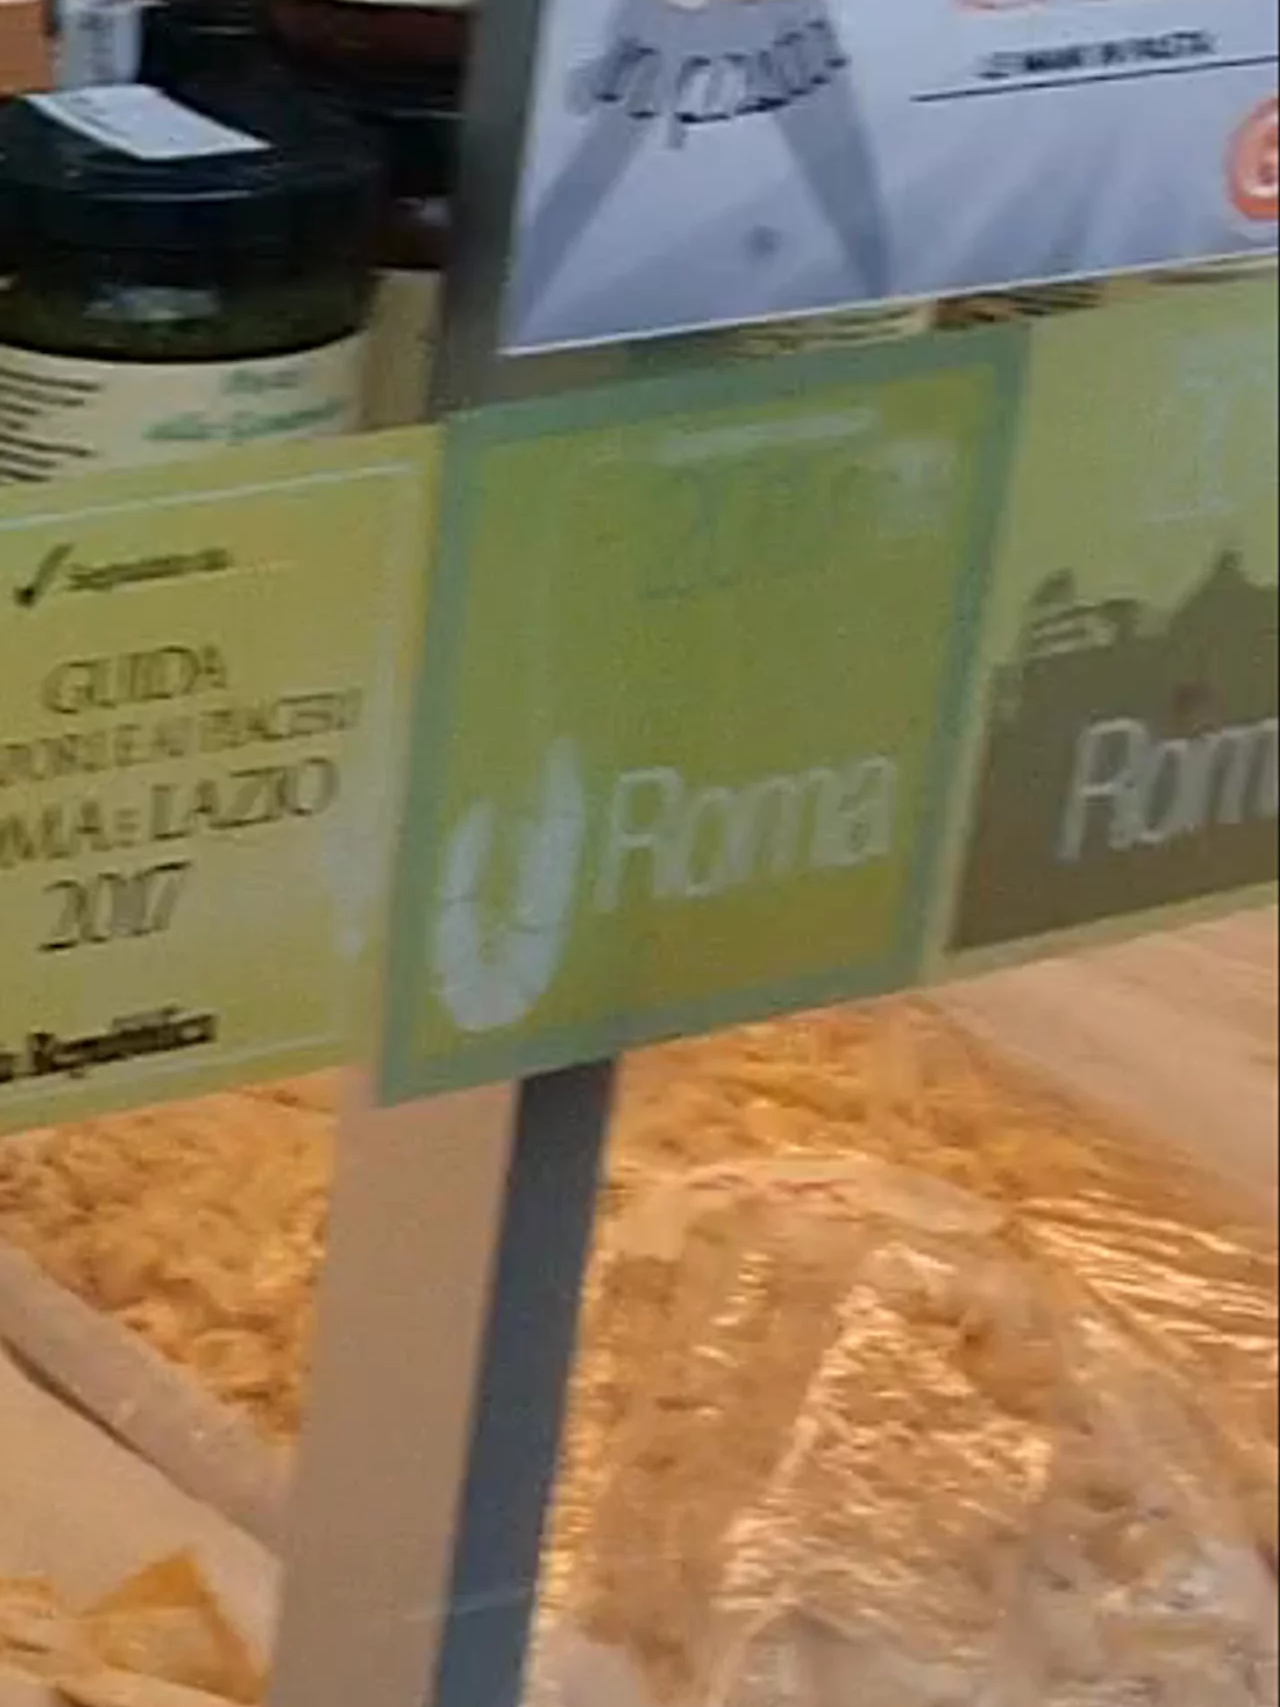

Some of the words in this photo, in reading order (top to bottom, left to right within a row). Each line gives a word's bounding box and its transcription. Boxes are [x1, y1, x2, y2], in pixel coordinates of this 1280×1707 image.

[43, 643, 229, 714] GUIDA
[147, 755, 339, 842] LAZIO
[594, 752, 900, 915] Roma
